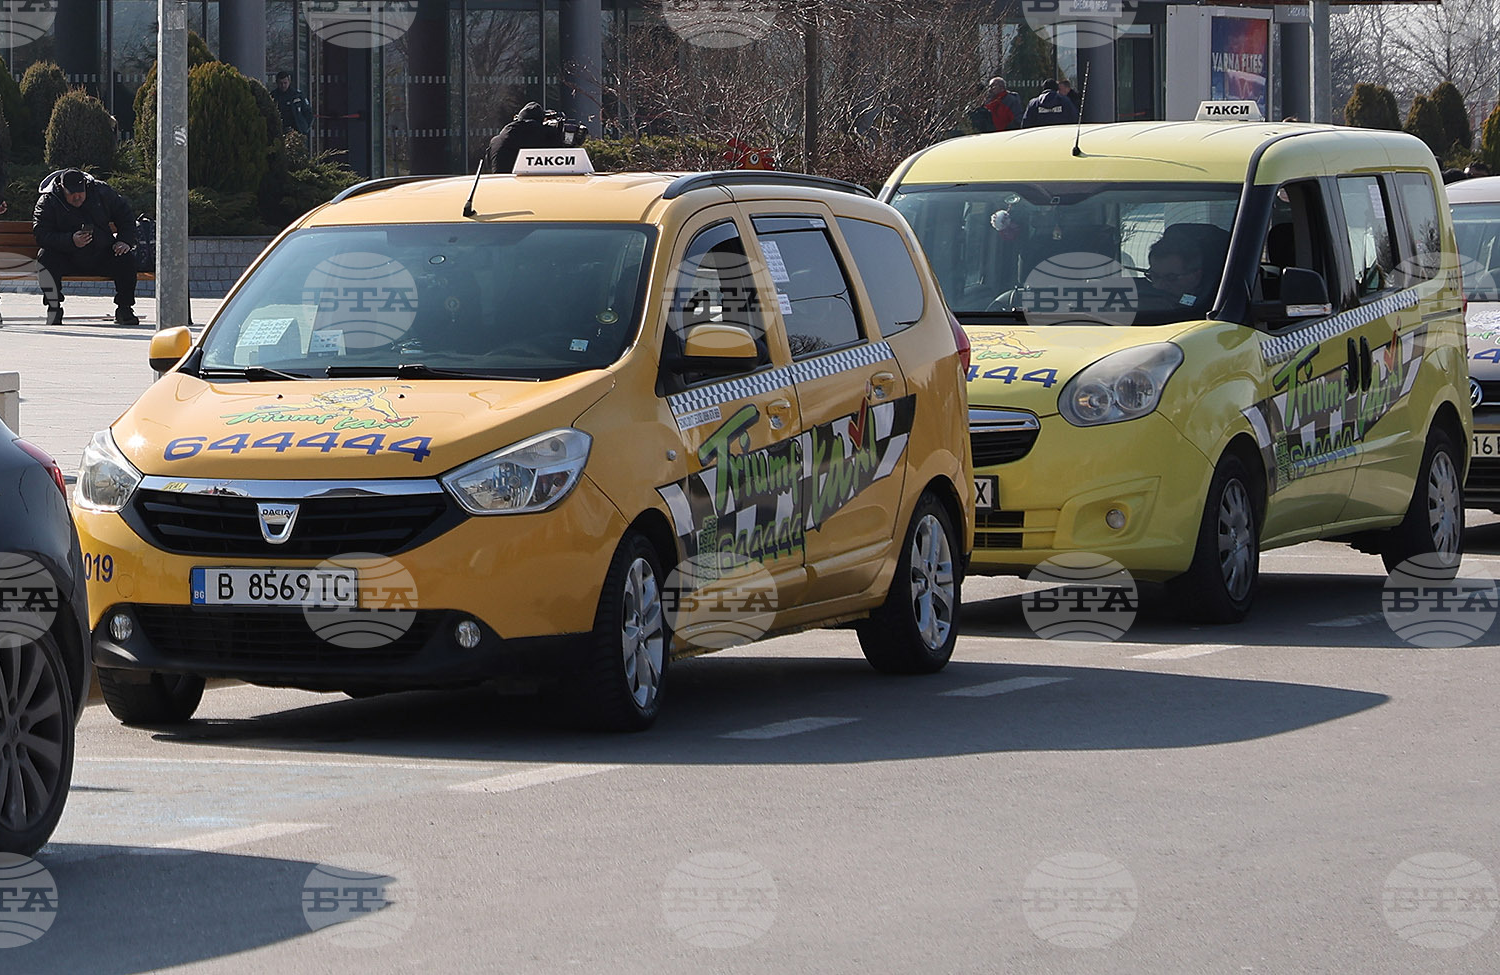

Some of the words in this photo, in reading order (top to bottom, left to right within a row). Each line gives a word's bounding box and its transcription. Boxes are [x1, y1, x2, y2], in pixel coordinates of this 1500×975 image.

[1211, 52, 1240, 73] VARNA
[1242, 53, 1263, 74] FLIES
[1205, 105, 1250, 115] ТАКСИ
[526, 156, 575, 166] ТАКСИ
[966, 365, 1058, 388] 444
[220, 410, 334, 426] Triumf
[333, 414, 414, 430] taxi
[163, 432, 432, 463] 644444
[1473, 435, 1493, 455] 16
[698, 404, 803, 512] Triumf
[974, 481, 988, 504] X
[262, 508, 291, 517] DACIA
[194, 590, 205, 599] BG
[217, 573, 234, 601] B
[248, 573, 311, 601] 8569
[316, 573, 350, 602] TC
